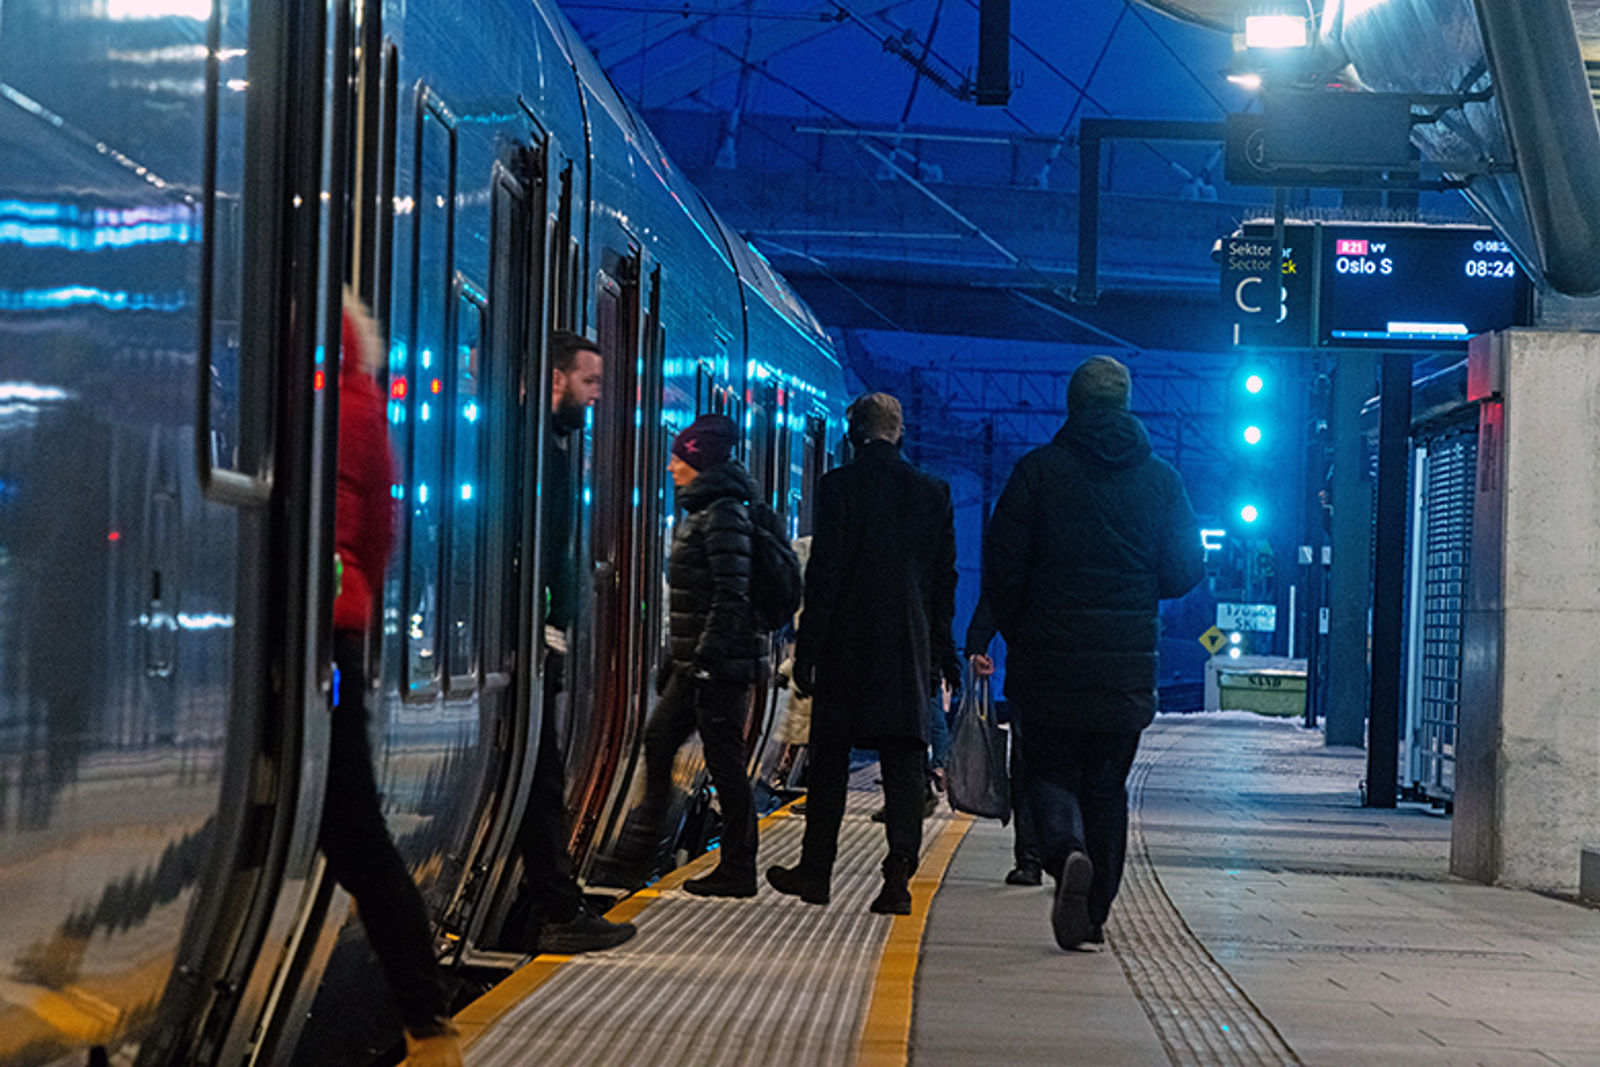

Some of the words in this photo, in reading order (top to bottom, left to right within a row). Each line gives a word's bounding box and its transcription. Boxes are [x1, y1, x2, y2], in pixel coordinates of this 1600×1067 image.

[1228, 241, 1273, 256] Sektor
[1341, 240, 1362, 253] R21
[1228, 256, 1272, 270] Sector
[1336, 257, 1376, 274] Oslo
[1380, 258, 1393, 275] S
[1465, 260, 1516, 278] 08:24
[1235, 276, 1262, 313] C
